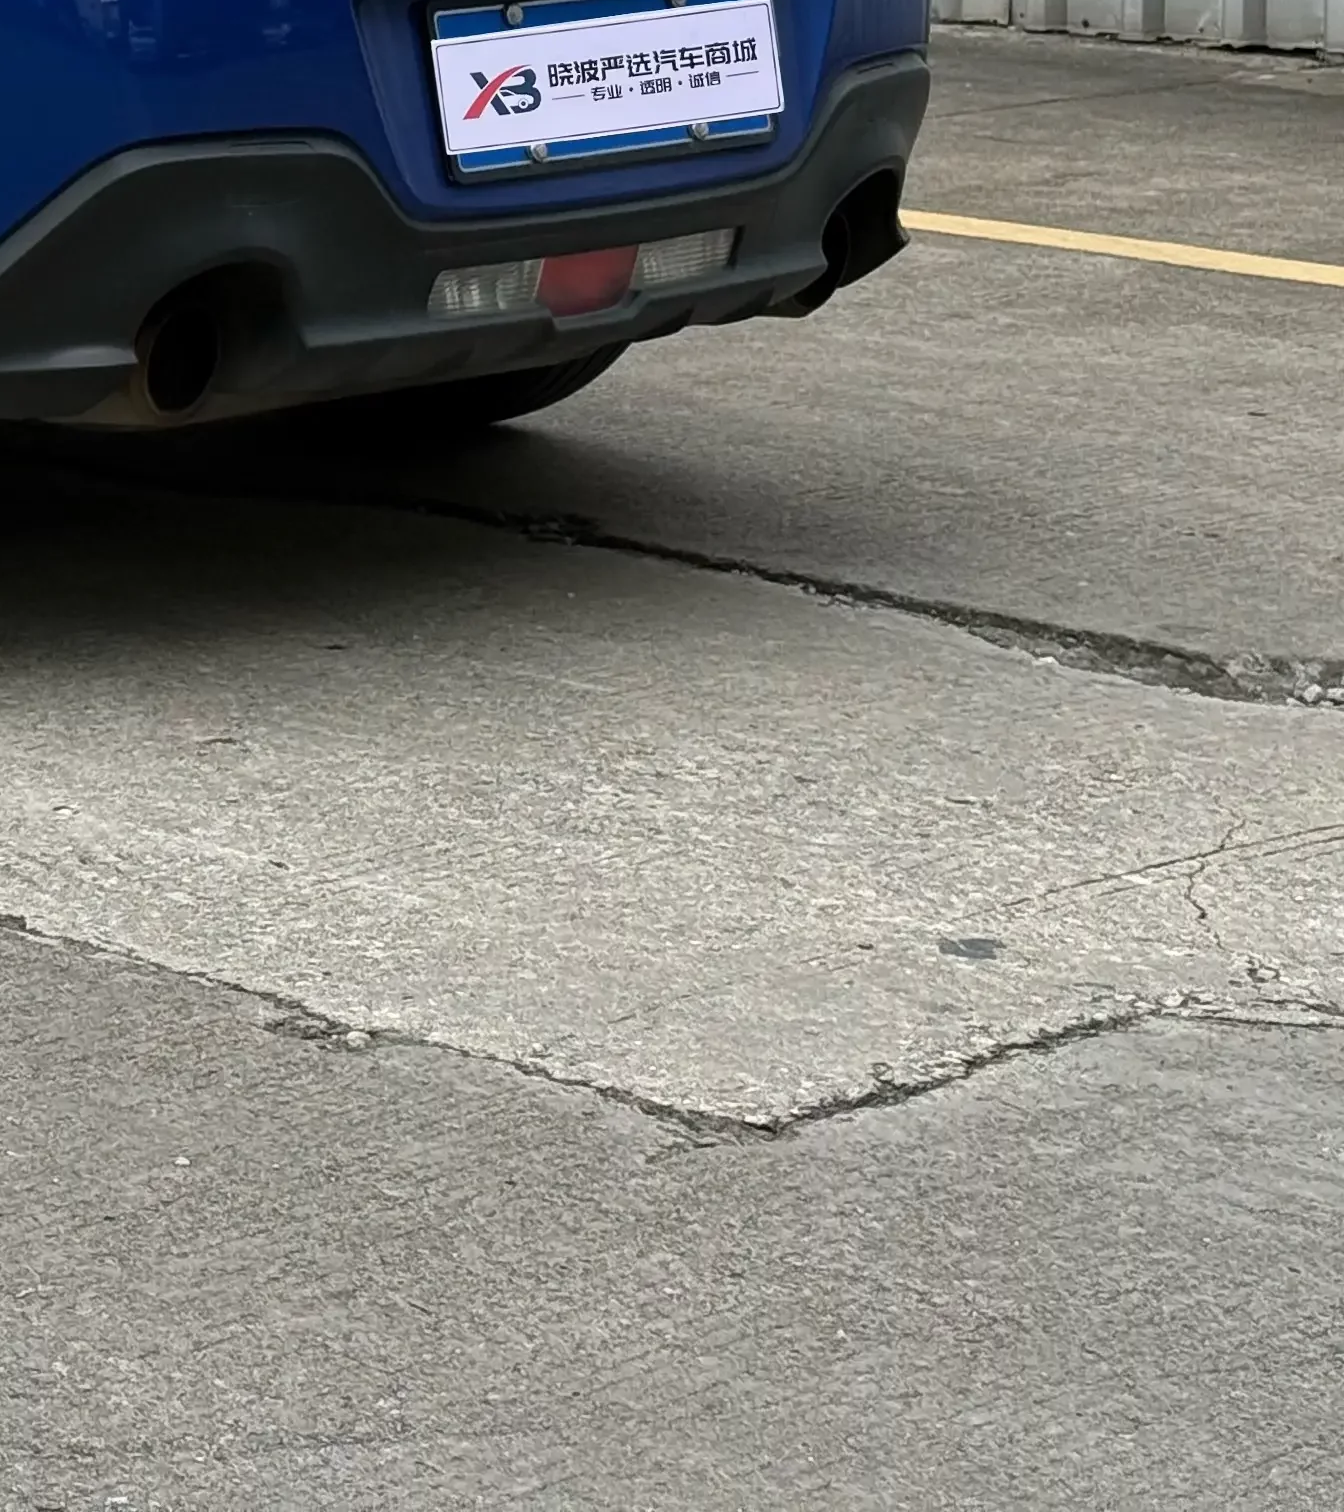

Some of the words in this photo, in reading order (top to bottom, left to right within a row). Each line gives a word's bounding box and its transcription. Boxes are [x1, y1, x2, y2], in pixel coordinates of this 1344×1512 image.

[547, 37, 758, 88] 晓波严选汽车商城
